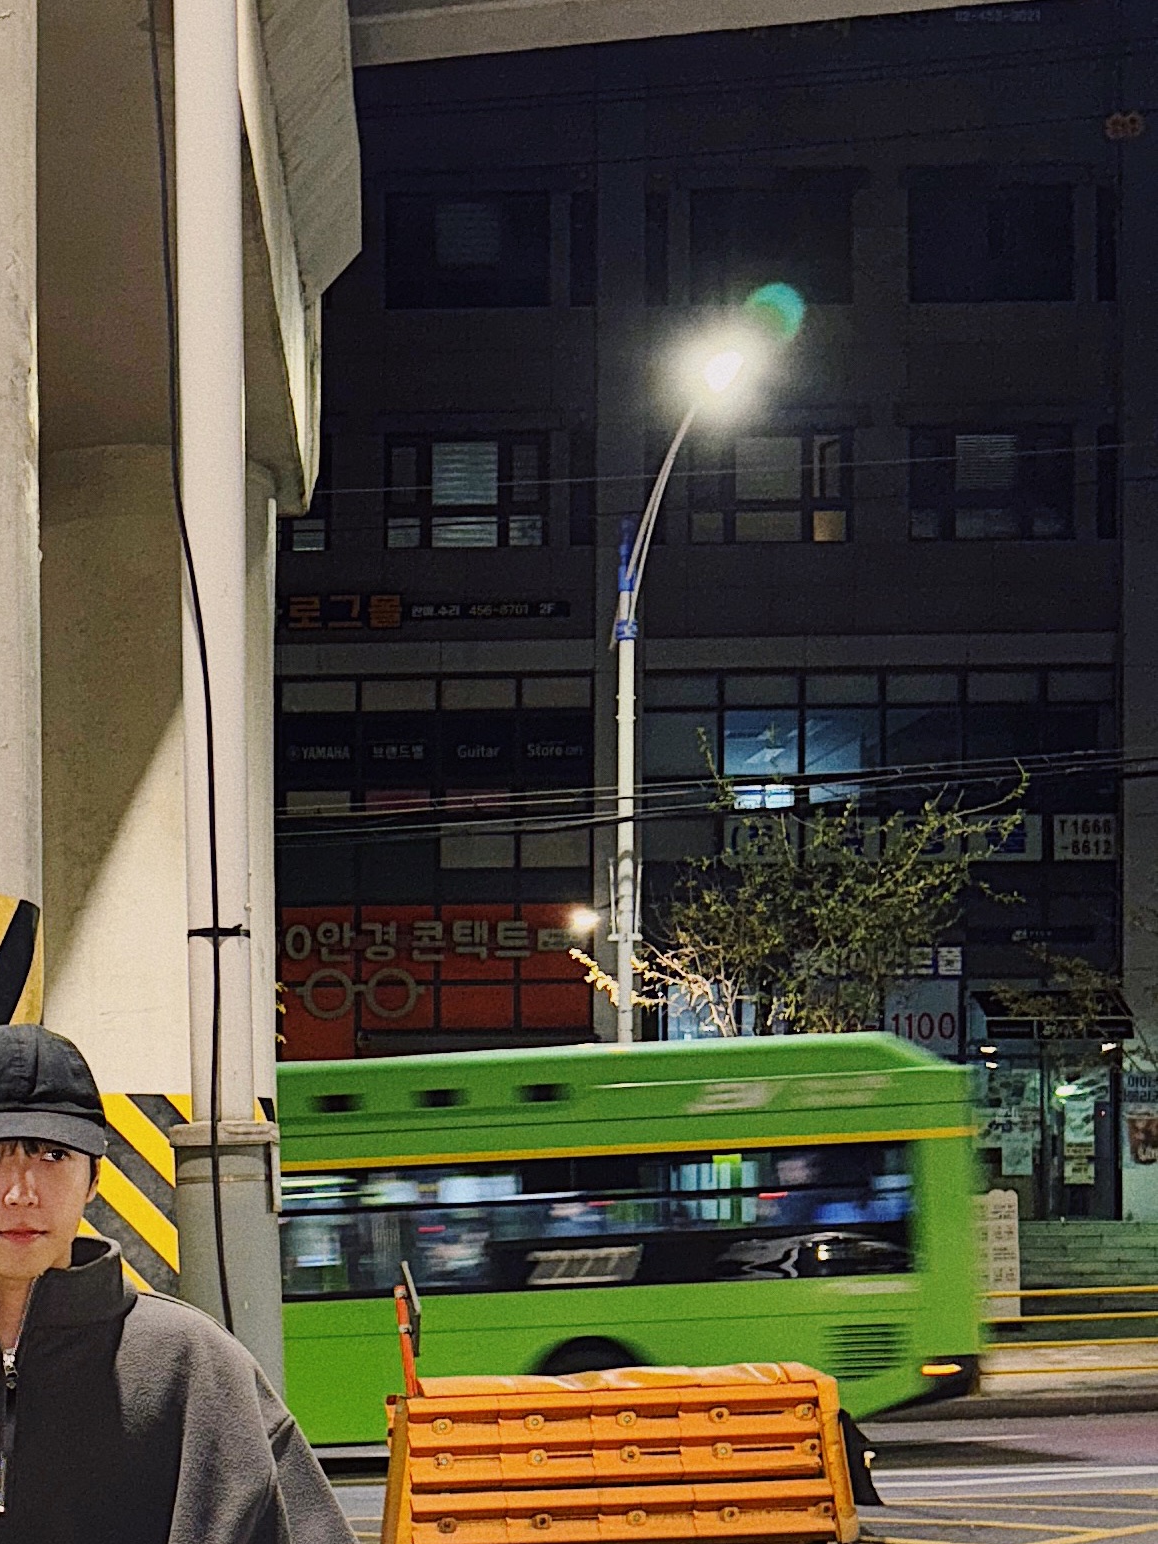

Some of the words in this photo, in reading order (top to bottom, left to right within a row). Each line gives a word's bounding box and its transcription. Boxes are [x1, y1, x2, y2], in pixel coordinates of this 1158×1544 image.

[277, 594, 402, 630] 로그몰
[301, 744, 350, 760] YAMAHA
[457, 744, 500, 759] Guitar
[526, 743, 563, 758] Store
[277, 921, 397, 963] 0안경
[411, 919, 532, 963] 콘택트
